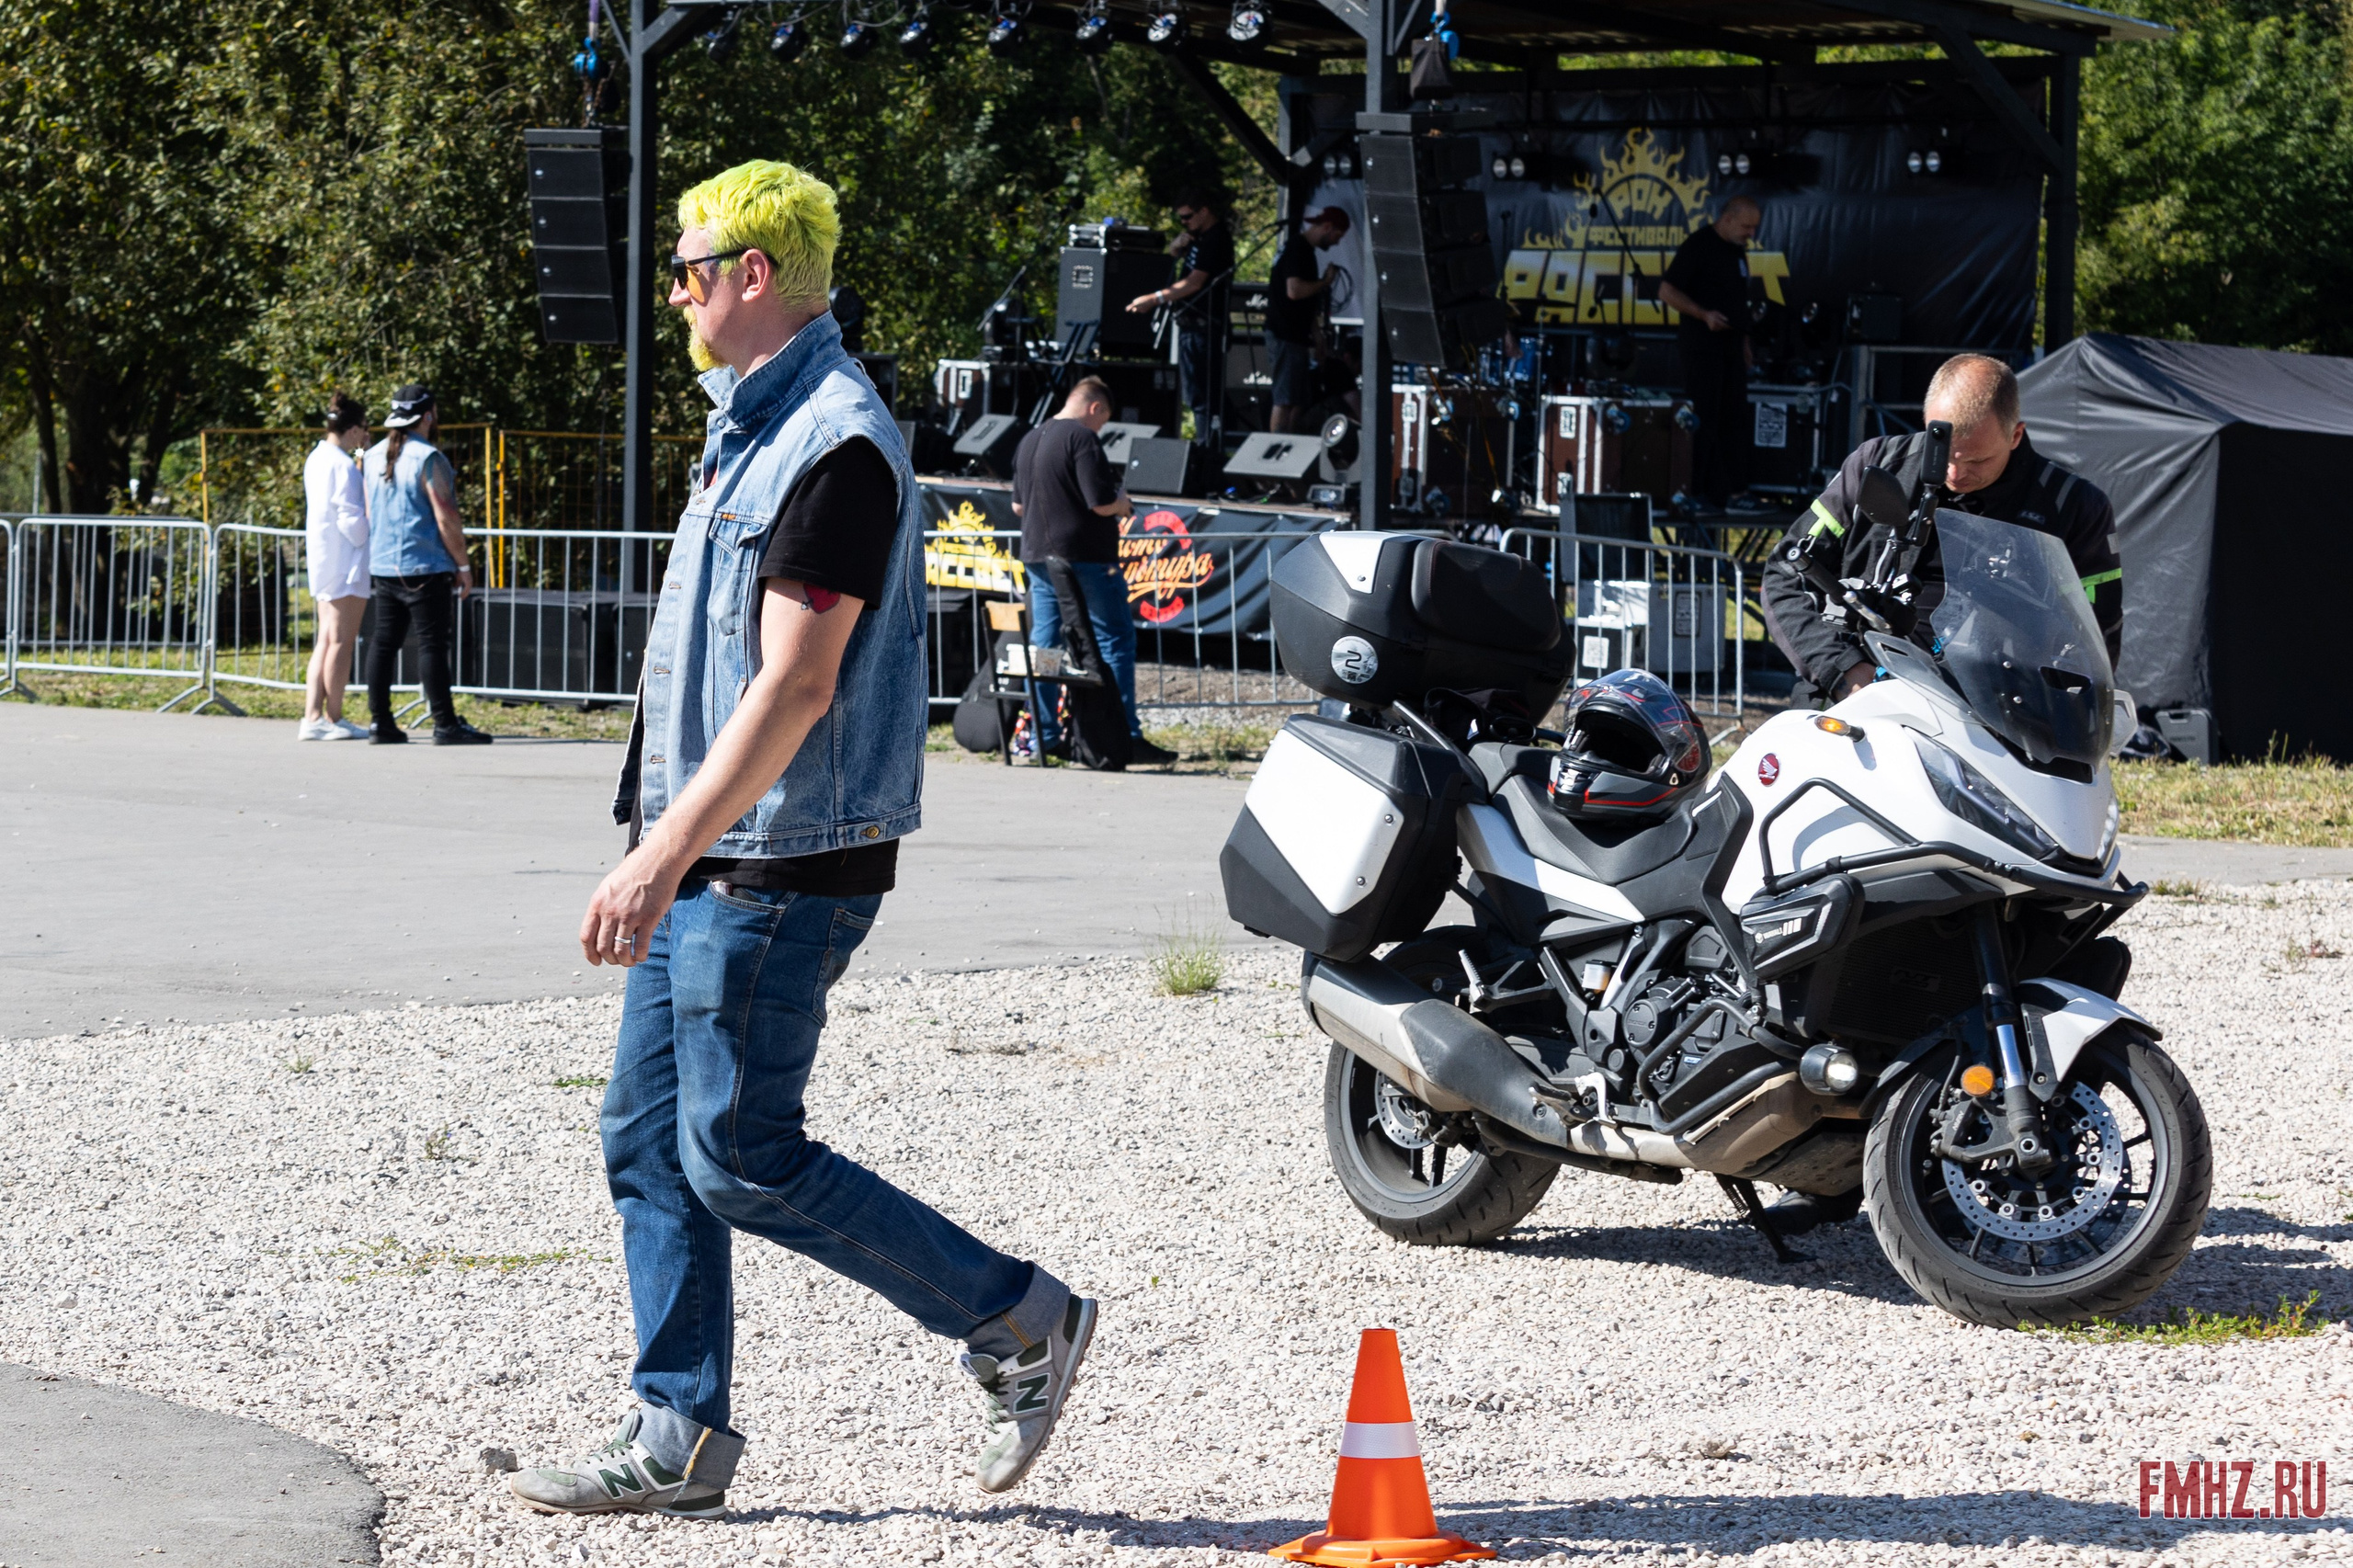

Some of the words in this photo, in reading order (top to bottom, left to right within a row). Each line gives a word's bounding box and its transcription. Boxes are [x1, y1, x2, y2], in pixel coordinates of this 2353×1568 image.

[1608, 179, 1673, 221] РОК
[1496, 250, 1790, 325] РАССТ
[925, 550, 1026, 594] АССВЕТ
[598, 1461, 647, 1500] N
